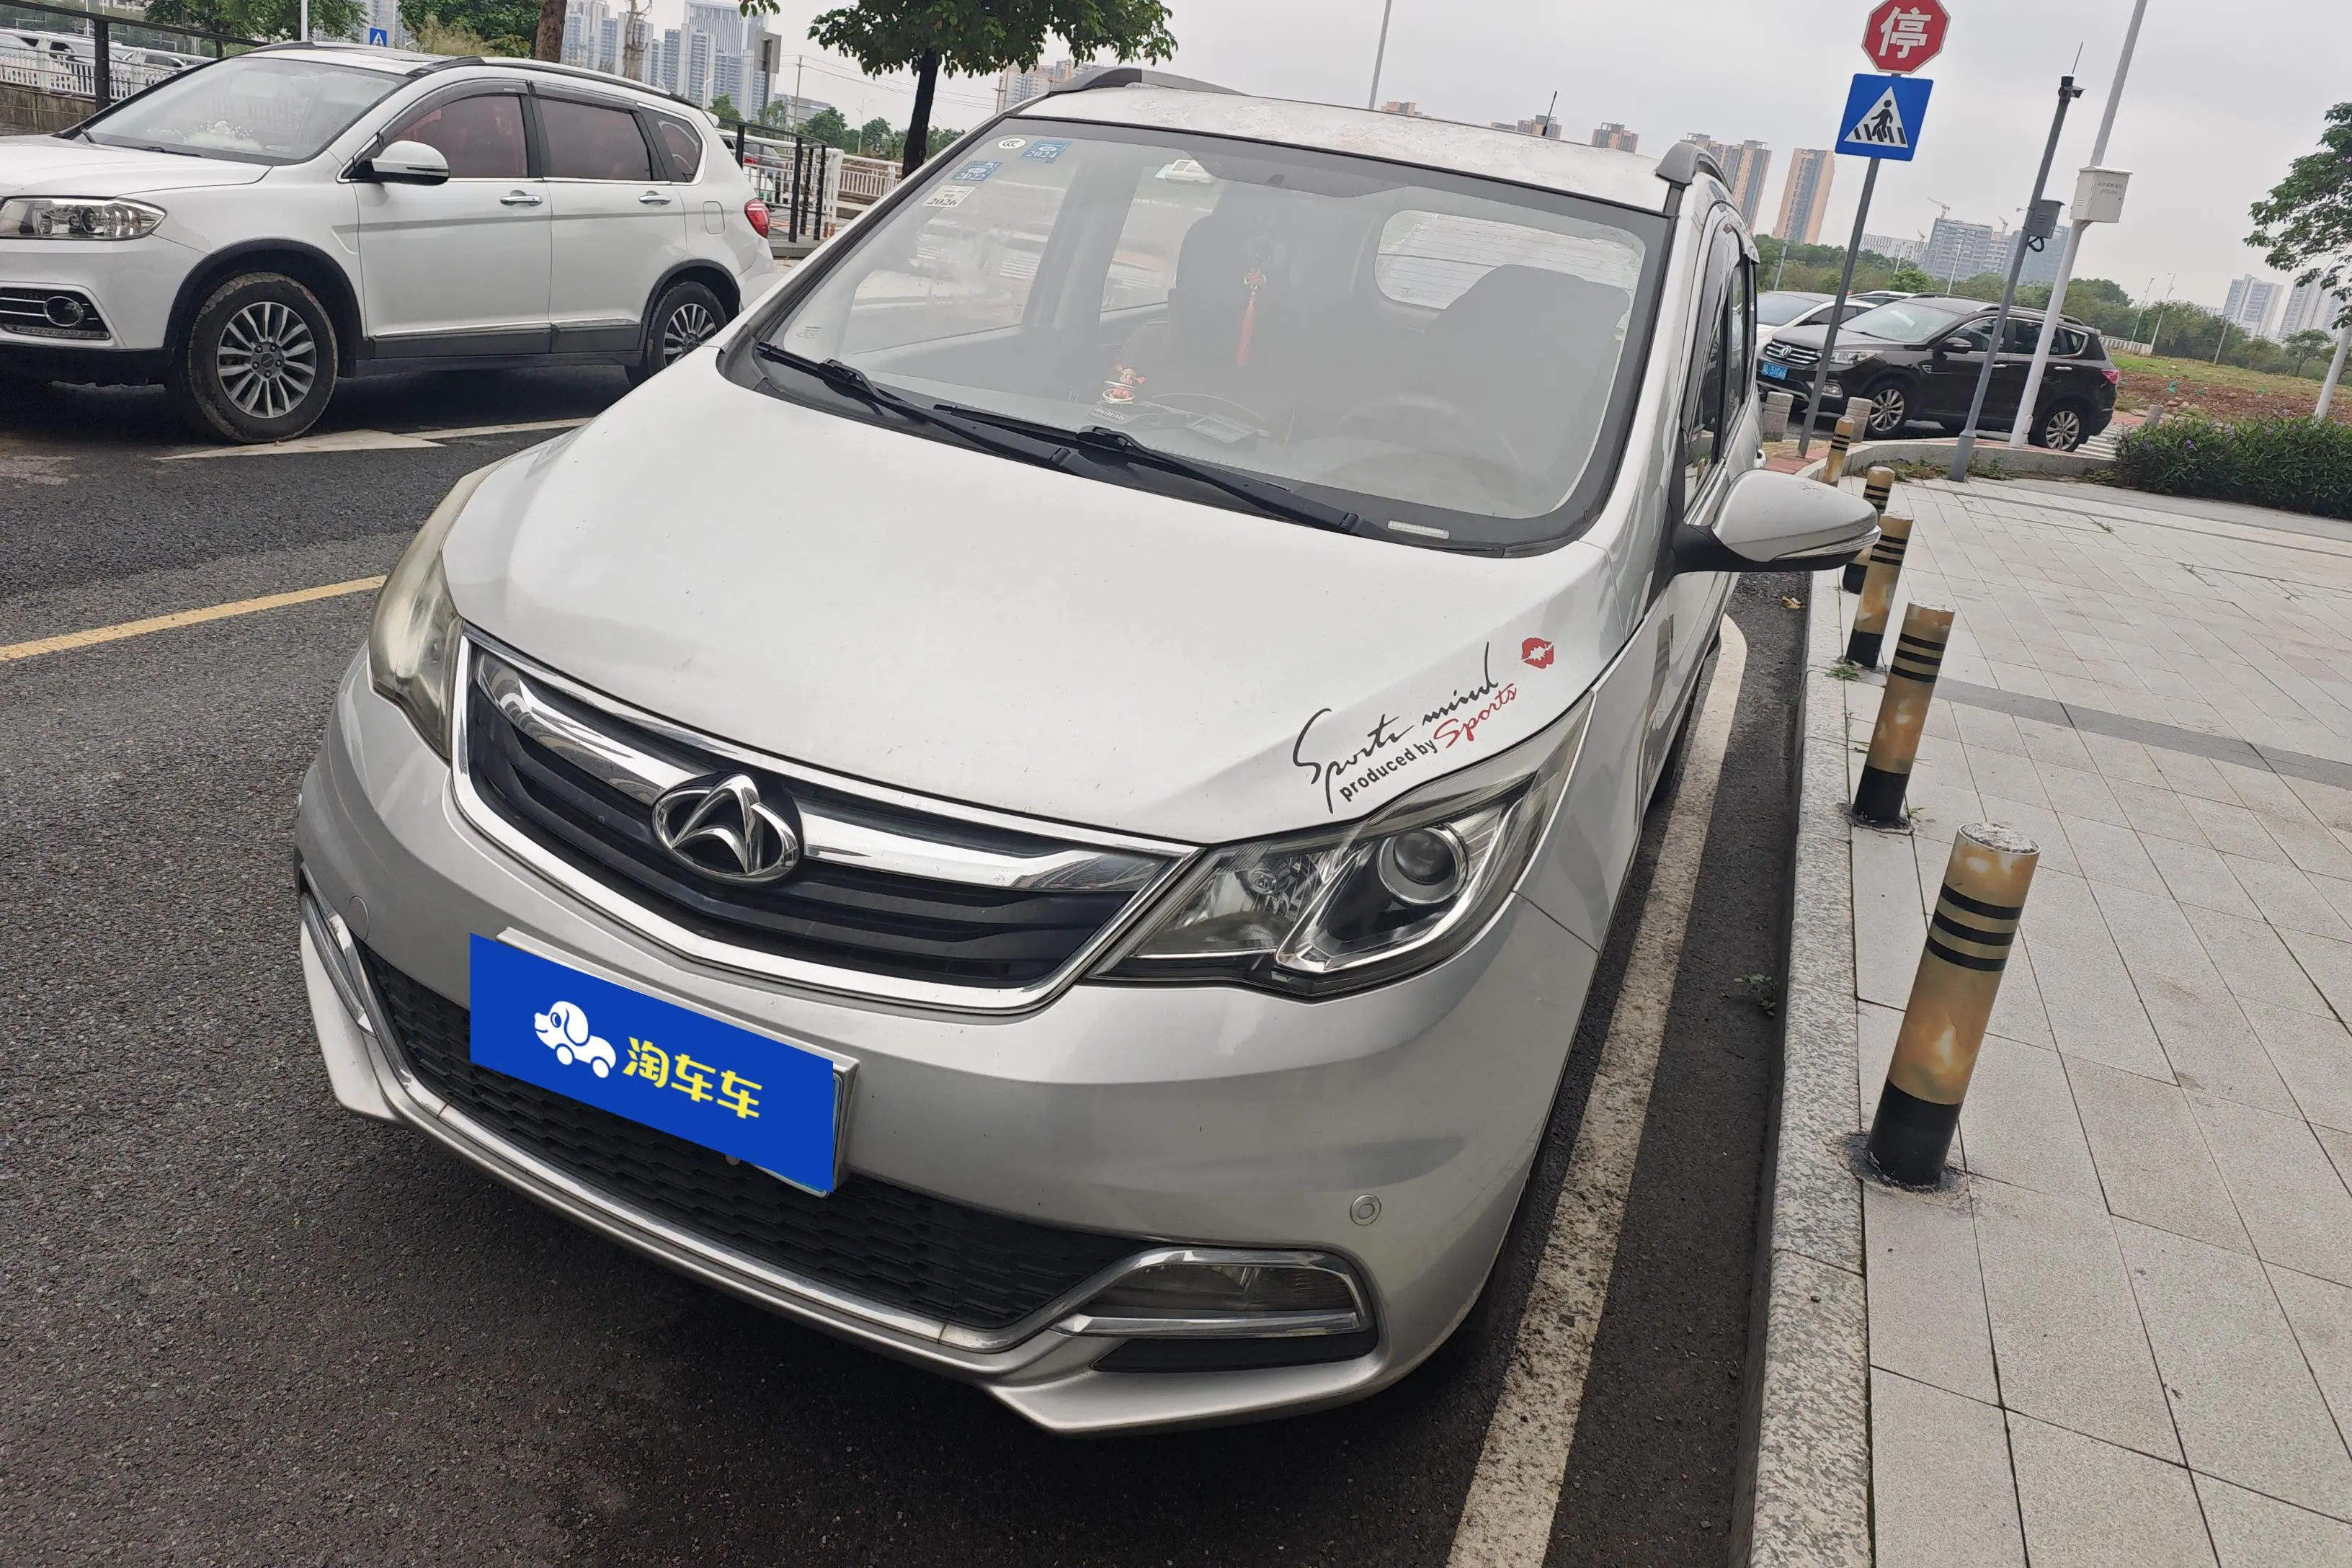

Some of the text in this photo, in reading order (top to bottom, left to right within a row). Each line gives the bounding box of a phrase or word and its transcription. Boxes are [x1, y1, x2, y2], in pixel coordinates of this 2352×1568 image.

[1879, 6, 1932, 58] 停
[1025, 150, 1059, 159] 2024
[927, 197, 957, 206] 2026
[1422, 641, 1498, 726] mind
[1339, 682, 1517, 802] produced by Sports
